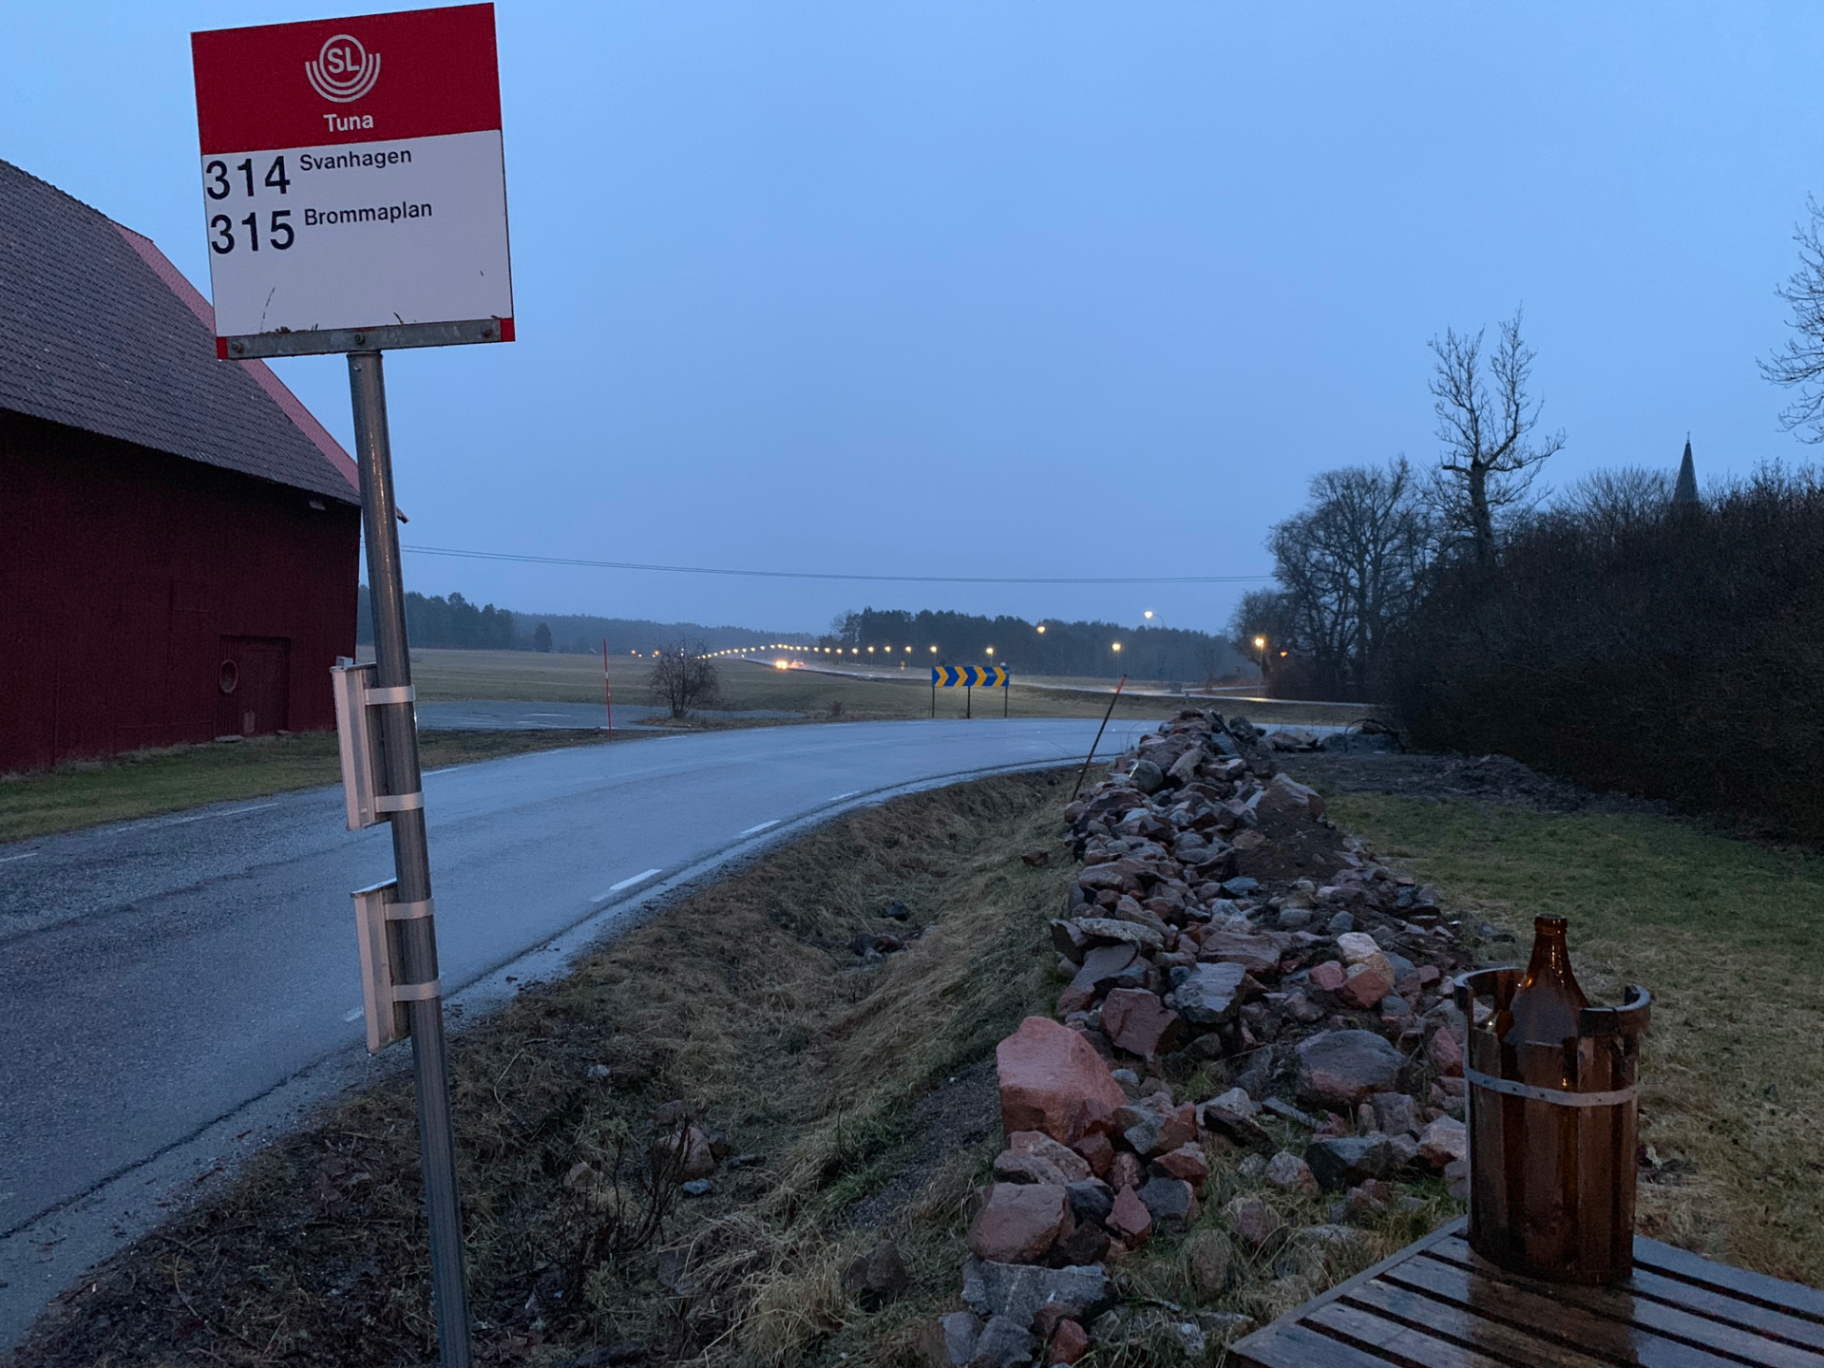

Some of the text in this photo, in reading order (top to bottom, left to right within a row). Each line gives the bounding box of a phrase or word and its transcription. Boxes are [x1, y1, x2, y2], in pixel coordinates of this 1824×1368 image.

[327, 47, 360, 74] SL
[323, 113, 374, 132] Tuna
[205, 149, 412, 201] 314 Svanhagen
[210, 201, 433, 255] 315 Brommaplan
